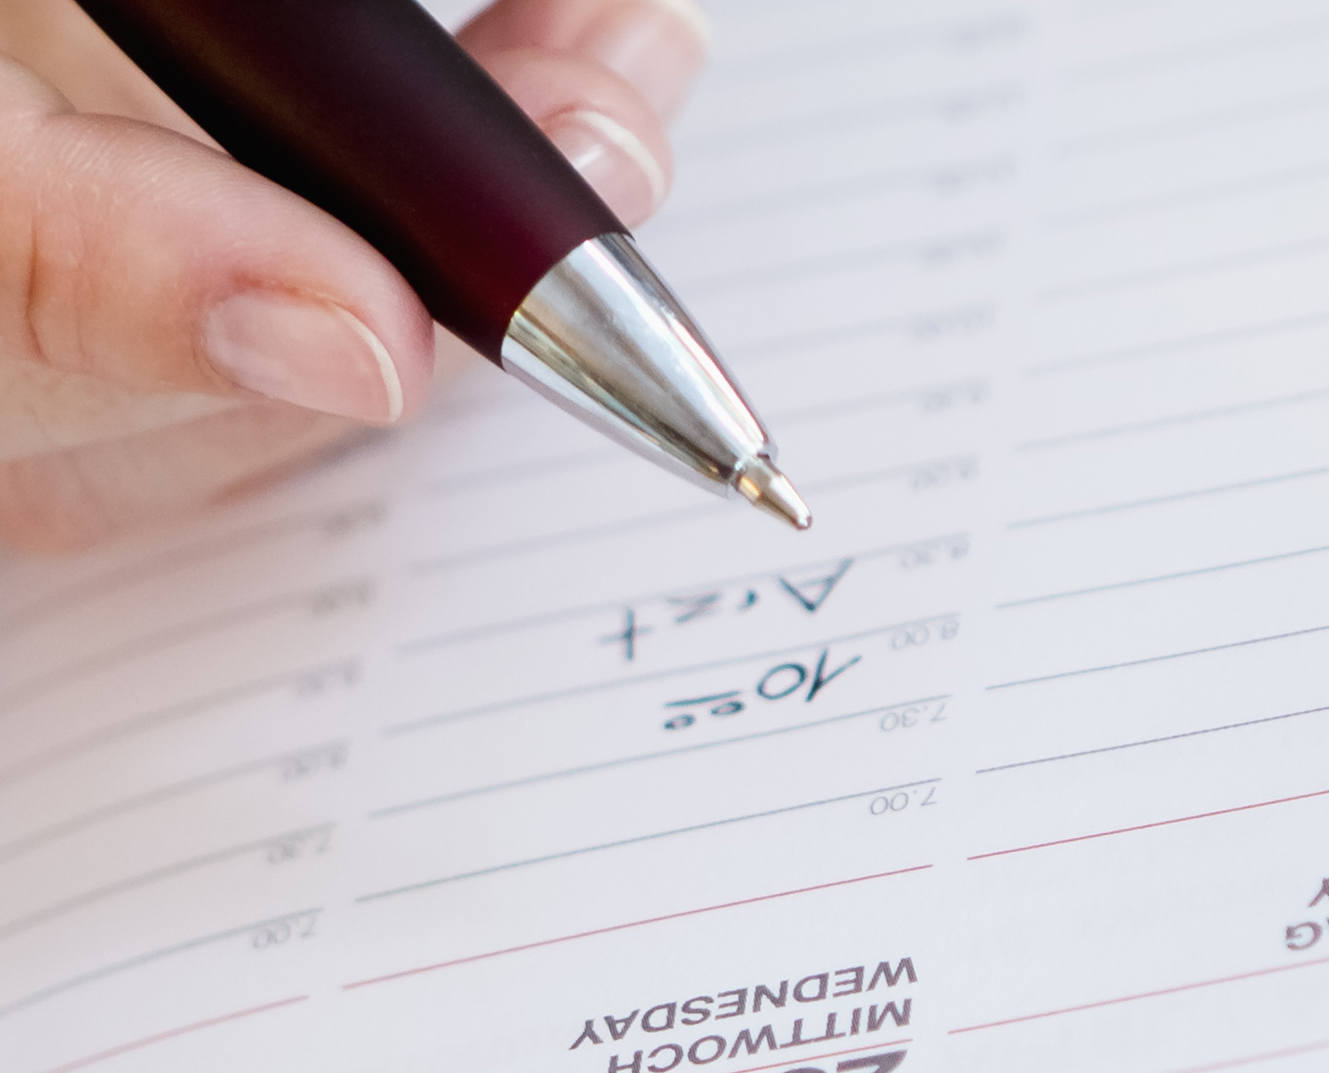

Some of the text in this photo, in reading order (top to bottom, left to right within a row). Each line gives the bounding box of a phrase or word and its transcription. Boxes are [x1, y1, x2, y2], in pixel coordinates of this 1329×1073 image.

[596, 557, 855, 663] Arzt
[890, 619, 960, 651] 8.00
[879, 702, 948, 732] 7.30
[869, 786, 938, 815] 7.00
[251, 916, 318, 950] 7.00
[569, 957, 918, 1050] WEDNESDAY
[608, 998, 912, 1073] MITTWOCH
